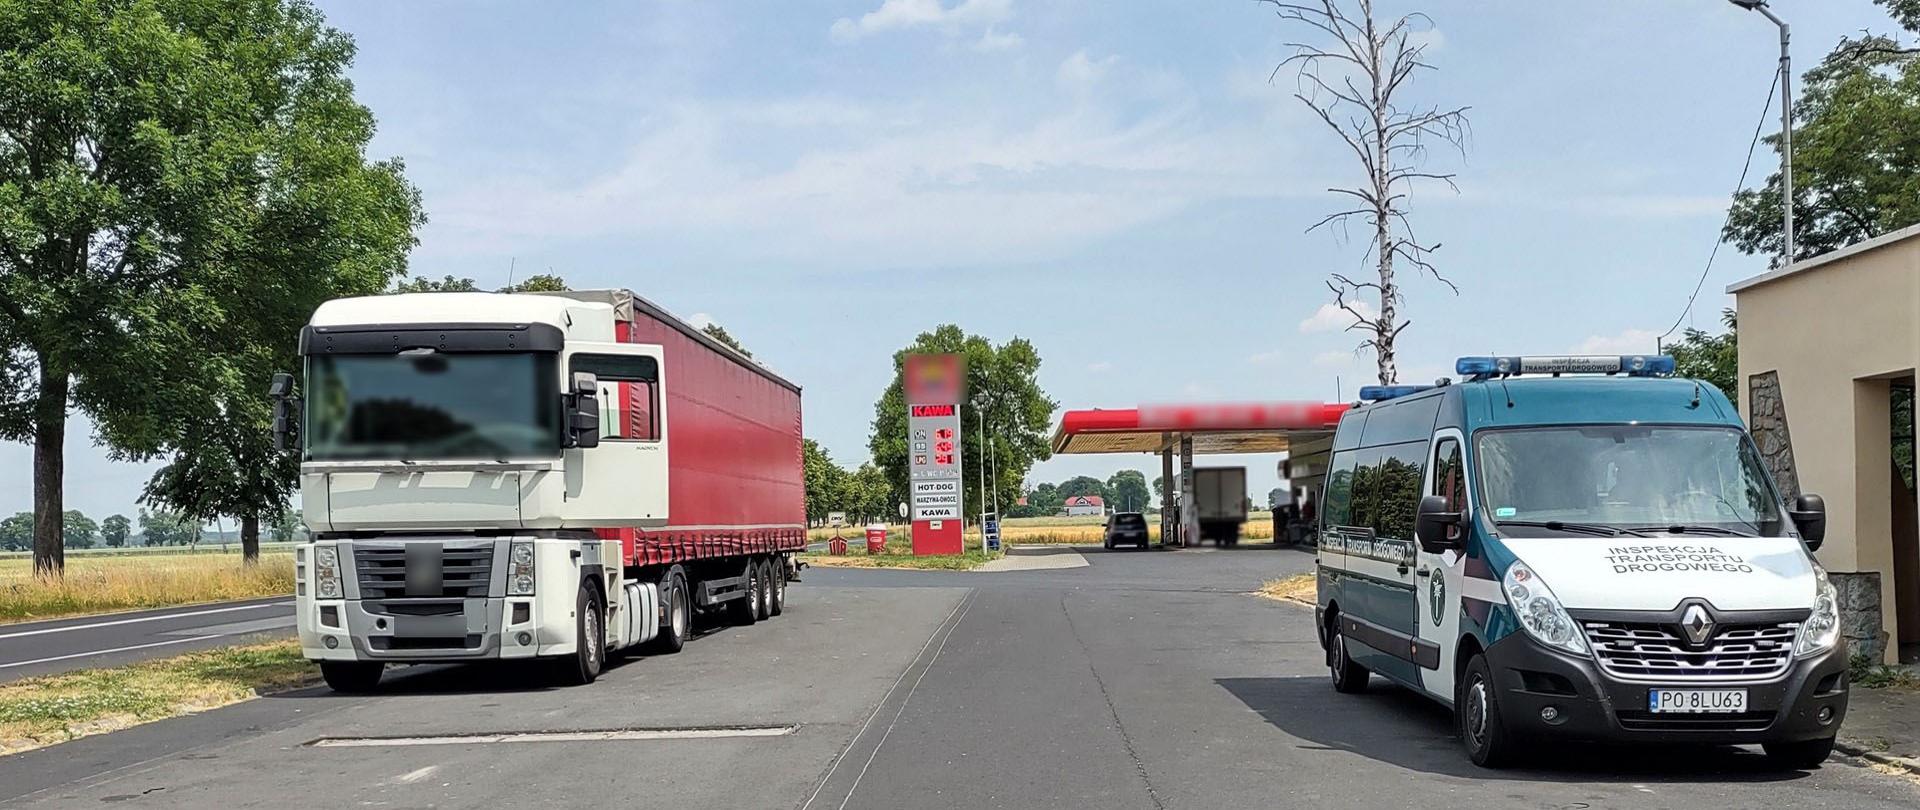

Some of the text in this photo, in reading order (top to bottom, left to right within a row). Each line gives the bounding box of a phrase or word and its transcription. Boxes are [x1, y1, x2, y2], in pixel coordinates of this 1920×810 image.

[1523, 364, 1569, 372] TRANSPORTU
[914, 406, 953, 417] KAWA
[915, 430, 926, 439] ON
[915, 456, 926, 464] LPG
[1347, 538, 1372, 555] TRANSPORTU
[1373, 542, 1406, 561] DROGOWEGO
[1608, 545, 1724, 555] INSPEKCJA
[1604, 554, 1744, 564] TRANSPORTU
[1613, 562, 1754, 574] DROGOWEGO
[1662, 692, 1684, 708] PO
[1690, 692, 1743, 708] 8LU63
